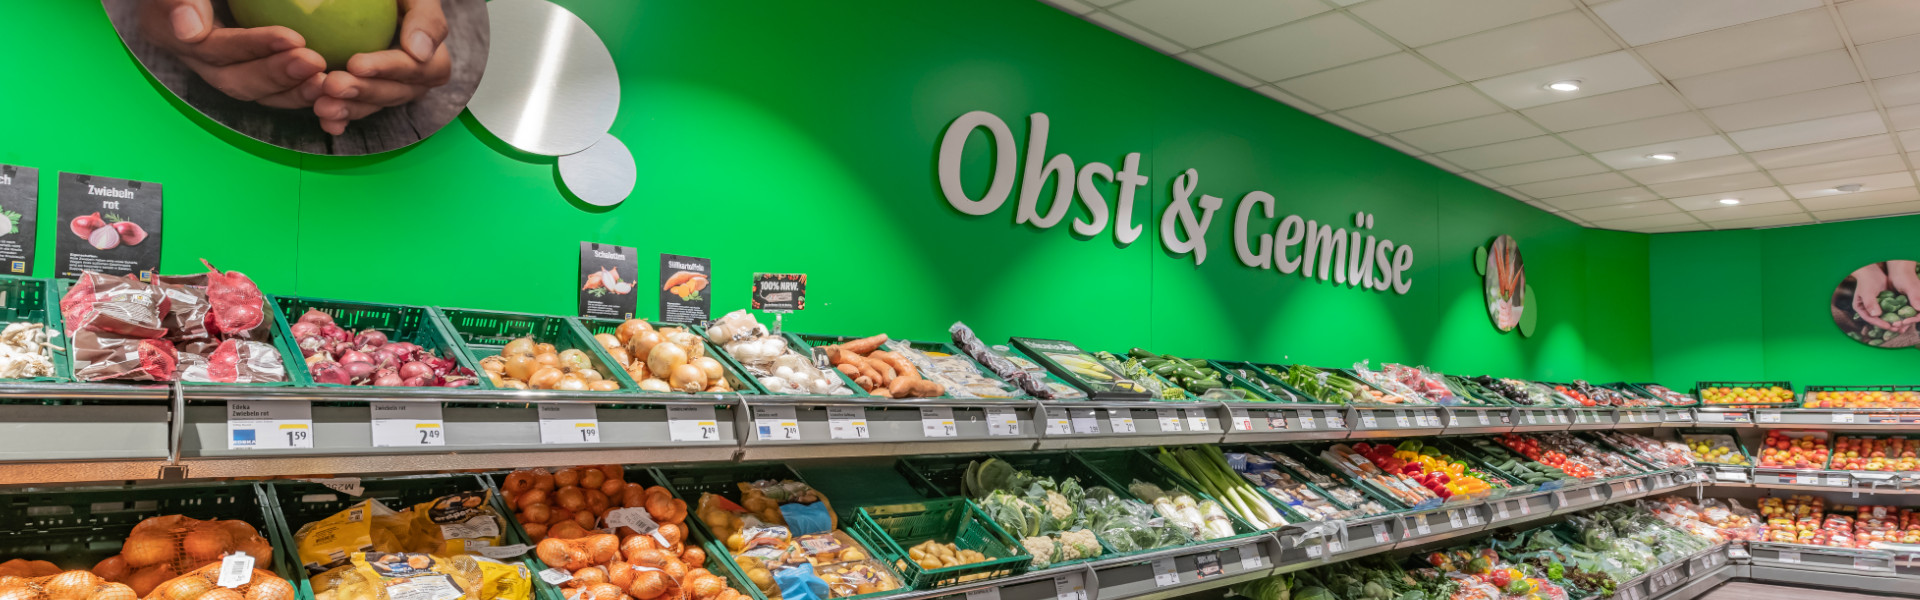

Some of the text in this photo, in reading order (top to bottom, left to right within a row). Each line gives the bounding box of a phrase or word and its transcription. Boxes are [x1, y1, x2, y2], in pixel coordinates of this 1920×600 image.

[88, 184, 134, 199] Zwiebeln
[102, 200, 120, 210] rot
[938, 110, 1414, 294] Obst & Gemüse
[760, 281, 799, 291] 100% NRW.
